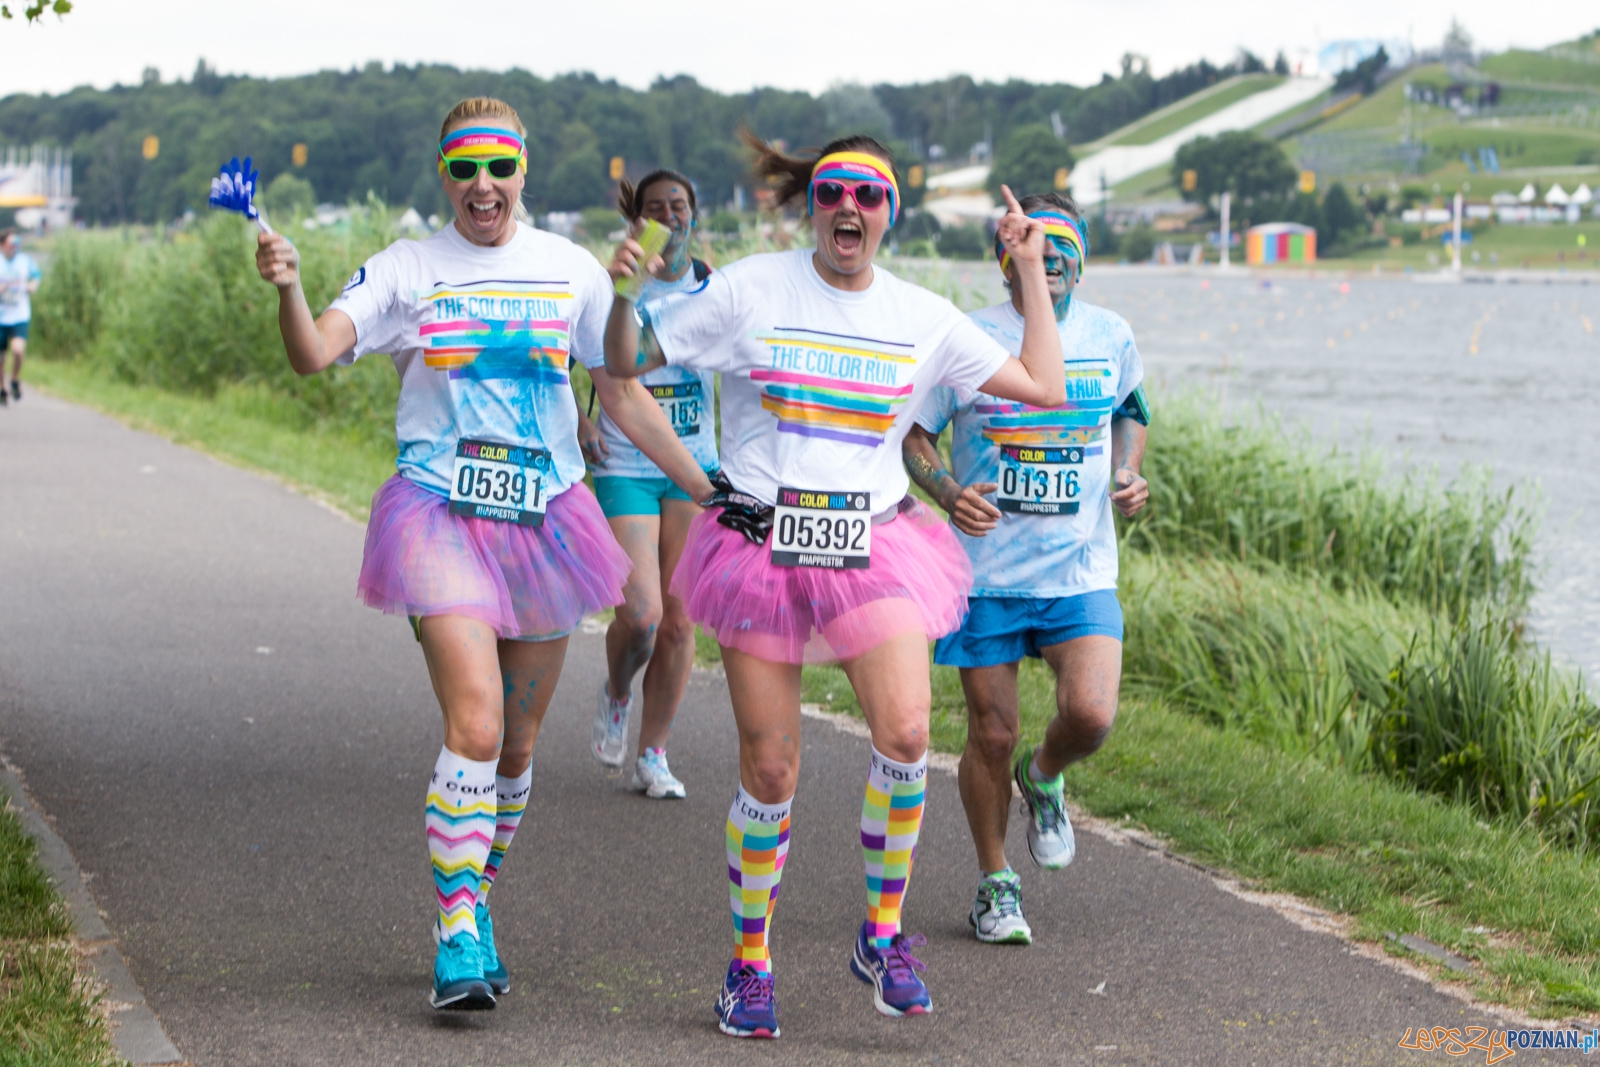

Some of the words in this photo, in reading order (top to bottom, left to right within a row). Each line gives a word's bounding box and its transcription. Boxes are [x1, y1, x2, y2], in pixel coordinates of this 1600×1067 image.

[434, 296, 465, 319] THE
[468, 297, 523, 319] COLOR
[525, 299, 559, 319] RUN
[770, 346, 803, 369] THE
[805, 350, 862, 381] COLOR
[864, 360, 897, 386] RUN
[463, 443, 480, 457] THE
[480, 445, 508, 461] COLOR
[1020, 449, 1046, 462] COLOR
[457, 465, 542, 508] 05391
[1003, 467, 1080, 498] 01316
[783, 491, 799, 506] THE
[800, 493, 829, 509] COLOR
[829, 495, 846, 509] RUN
[778, 514, 866, 550] 05392
